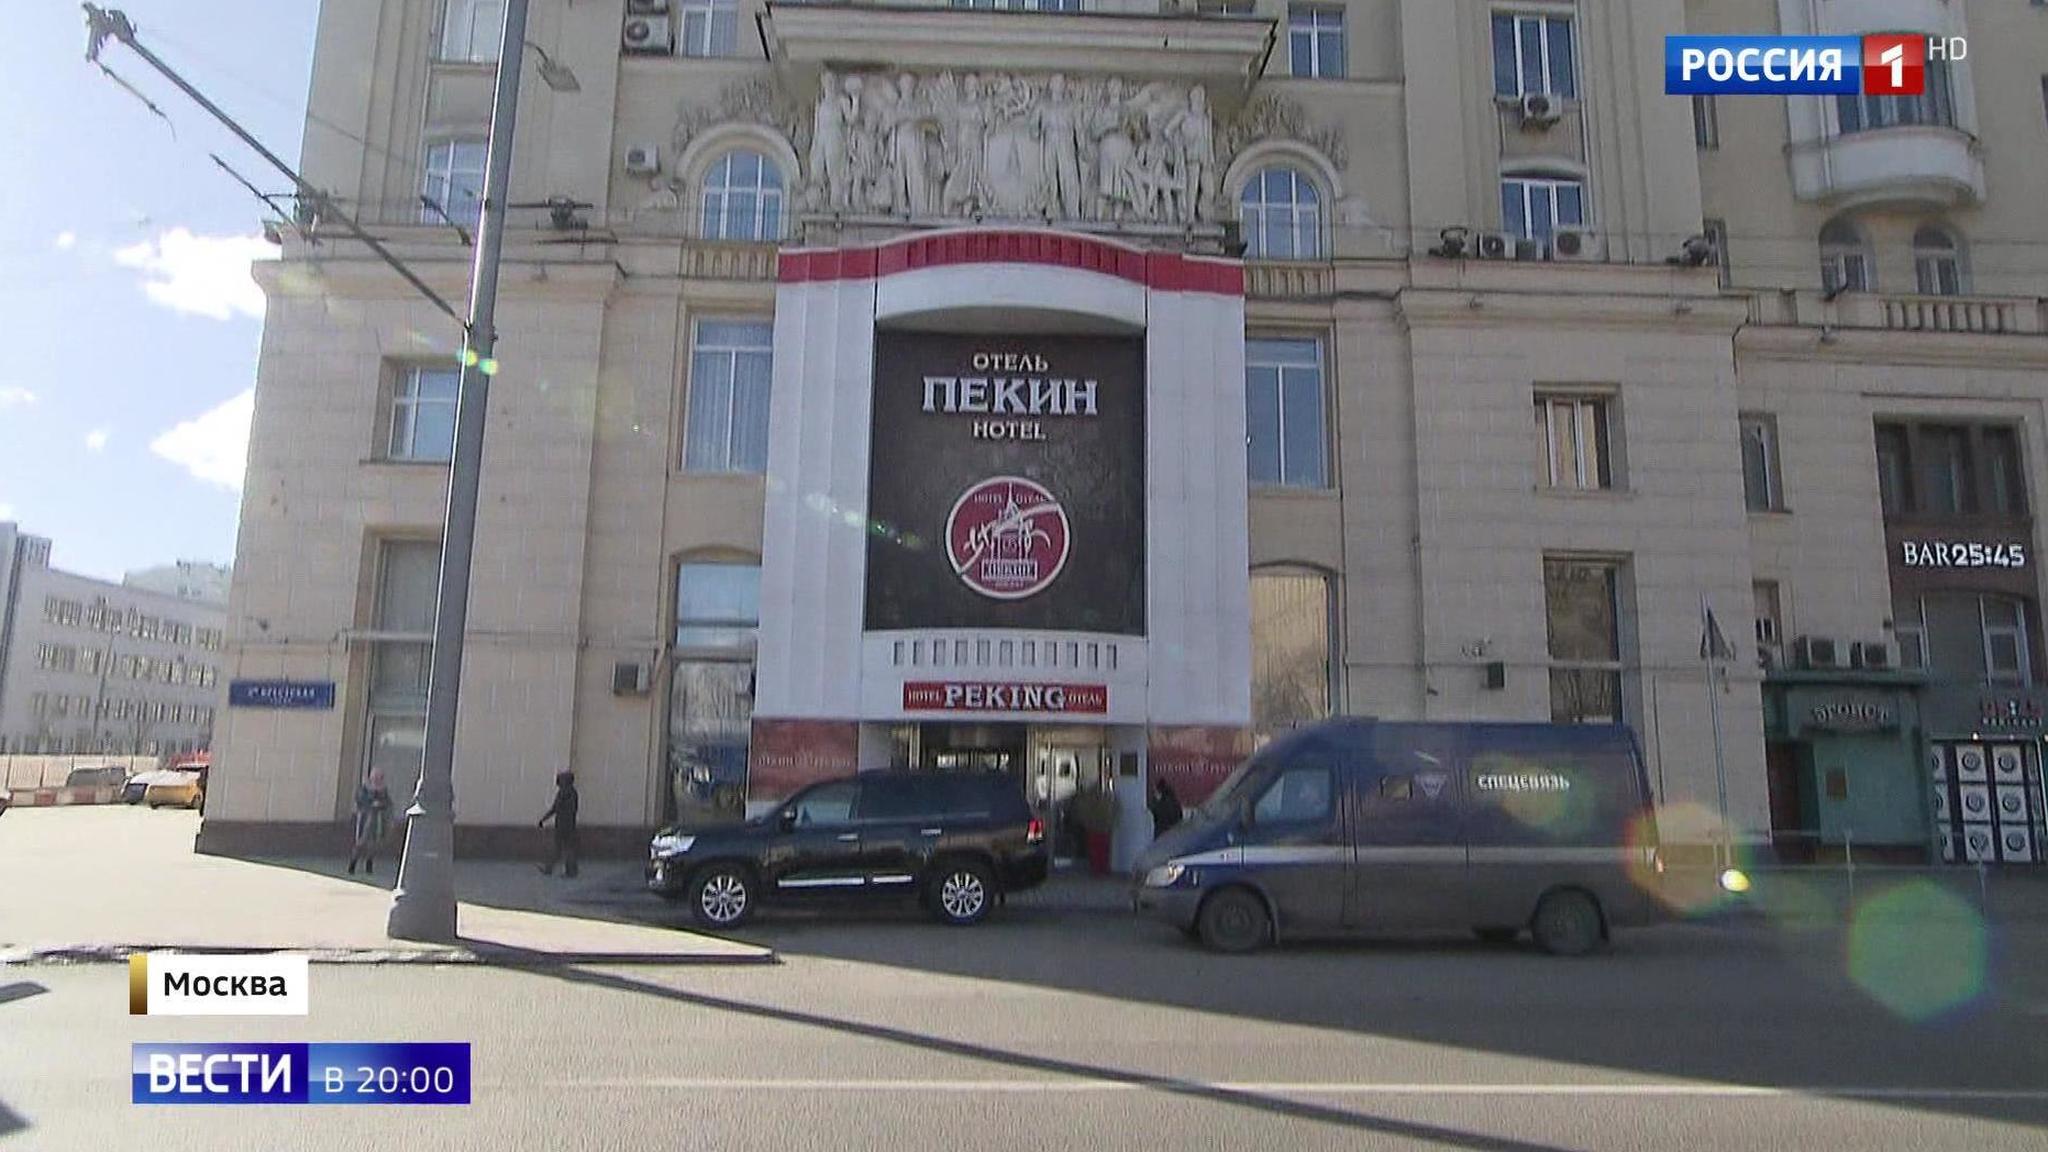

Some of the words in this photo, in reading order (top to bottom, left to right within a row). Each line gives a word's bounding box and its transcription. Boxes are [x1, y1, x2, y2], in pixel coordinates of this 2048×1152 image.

[972, 353, 1049, 373] ОТЕЛЬ
[922, 376, 1098, 416] ПЕКИН
[973, 420, 1046, 440] HOTEL
[944, 684, 1066, 710] PEKING
